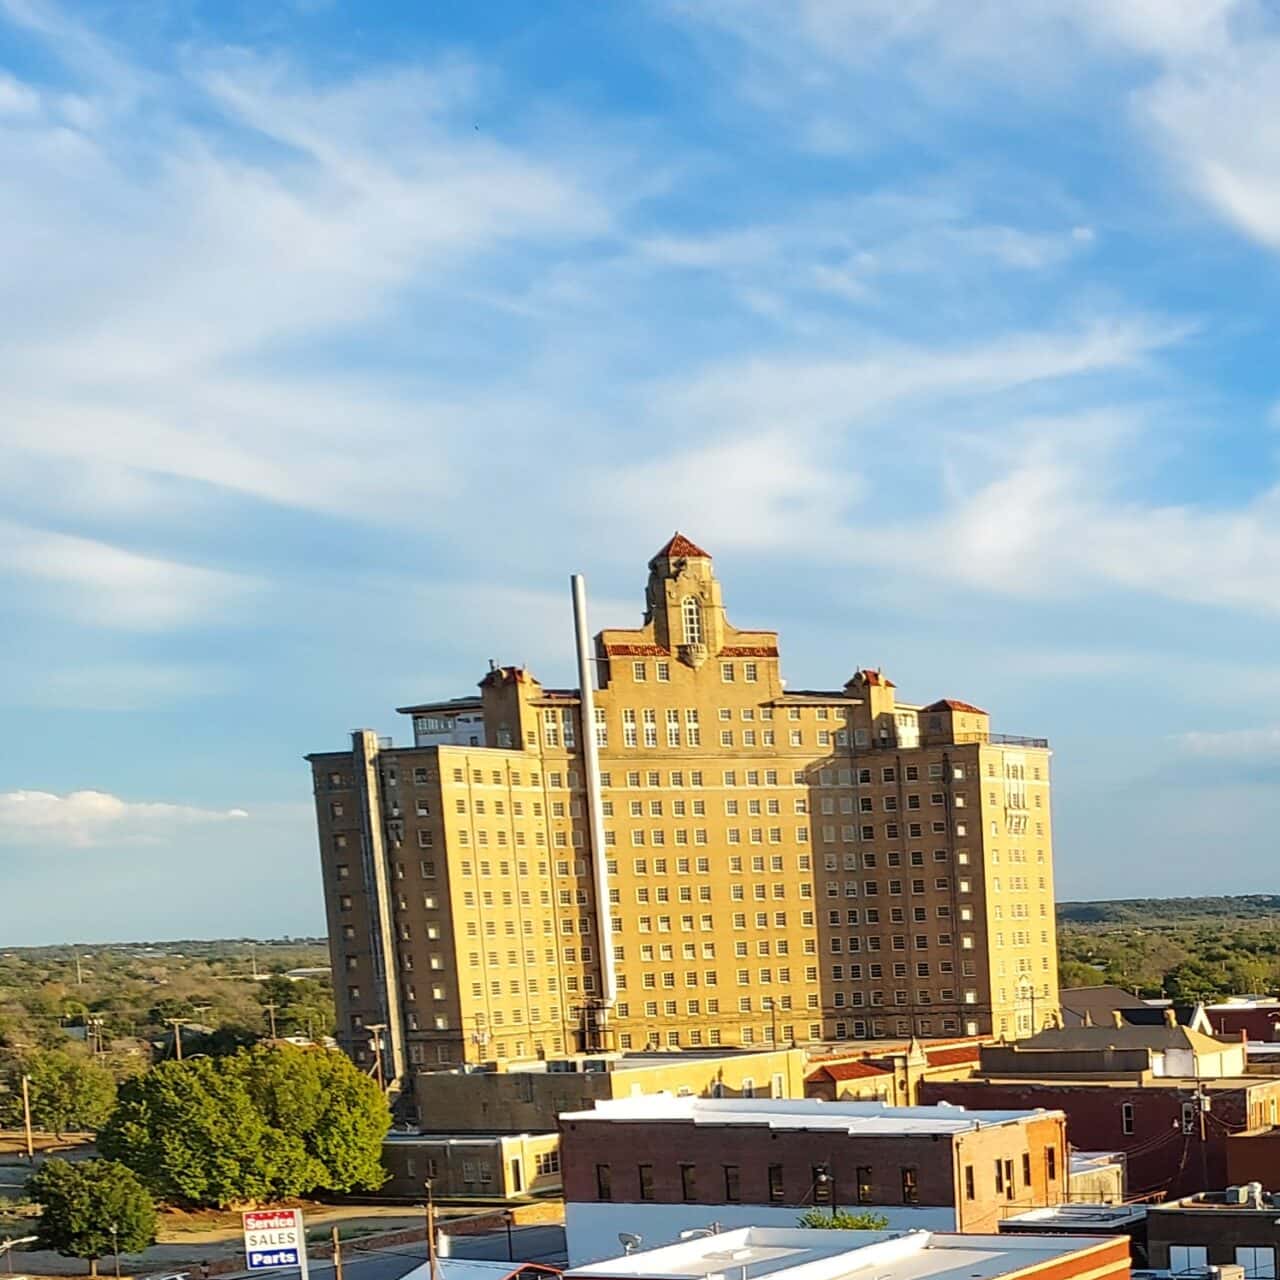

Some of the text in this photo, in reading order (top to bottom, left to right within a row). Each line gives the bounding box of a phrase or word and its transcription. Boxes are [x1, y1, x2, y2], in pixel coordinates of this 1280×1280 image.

[247, 1216, 294, 1229] Service
[249, 1232, 296, 1246] SALES
[252, 1252, 297, 1265] Parts
